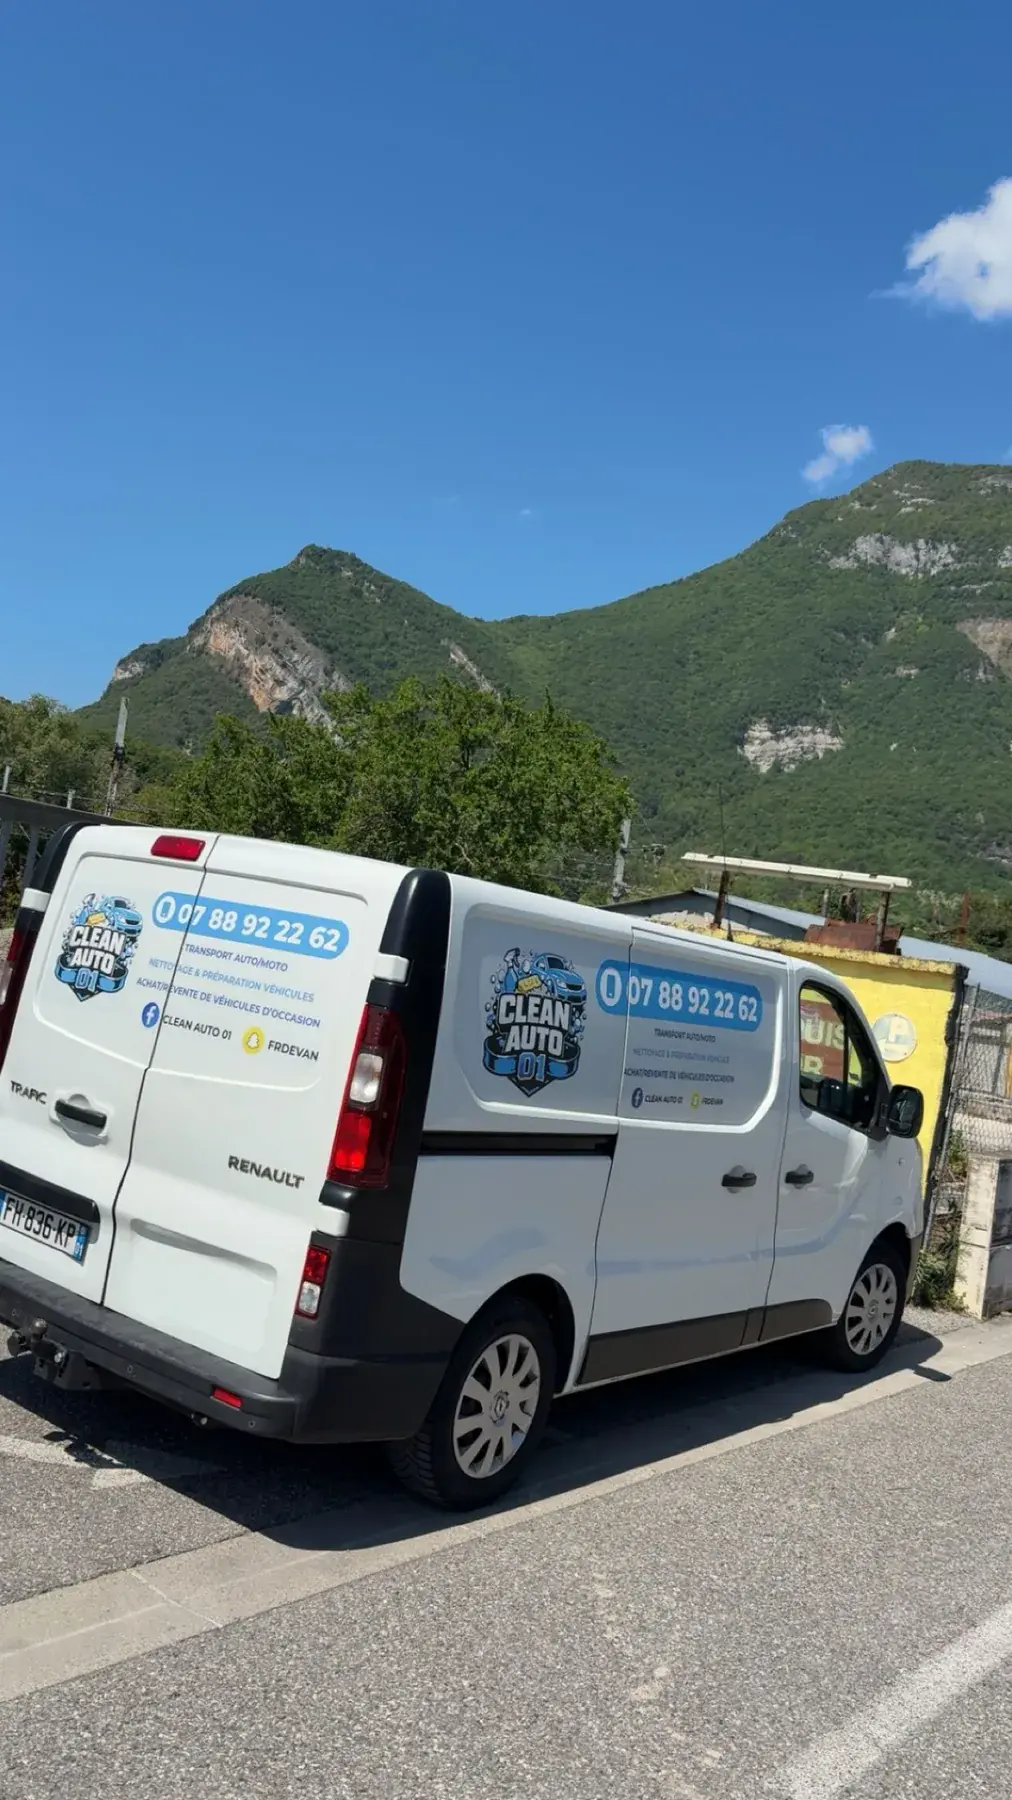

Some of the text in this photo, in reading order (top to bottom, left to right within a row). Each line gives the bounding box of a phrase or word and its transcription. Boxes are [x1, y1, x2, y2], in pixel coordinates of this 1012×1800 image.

[69, 926, 126, 956] CLEAN
[178, 903, 341, 952] 07 88 92 22 62
[69, 947, 116, 977] AUTO
[184, 943, 288, 972] TRANSPORT AUTO/MOTO
[74, 967, 99, 993] 01
[194, 968, 200, 977] &
[202, 969, 261, 991] PRÉPARATION
[264, 982, 315, 1003] VÉHICULES
[136, 977, 321, 1028] ACHAT/REVENTE DE VÉHICULES D'OCCASION
[498, 993, 571, 1031] CLEAN
[626, 975, 758, 1022] 07 88 92 22 62
[162, 1014, 232, 1041] CLEAN AUTO 01
[505, 1025, 563, 1057] AUTO
[654, 1028, 685, 1039] TRANSPORT
[267, 1039, 320, 1061] FRDEVAN
[517, 1051, 546, 1082] 01
[227, 1155, 305, 1189] RENAULT
